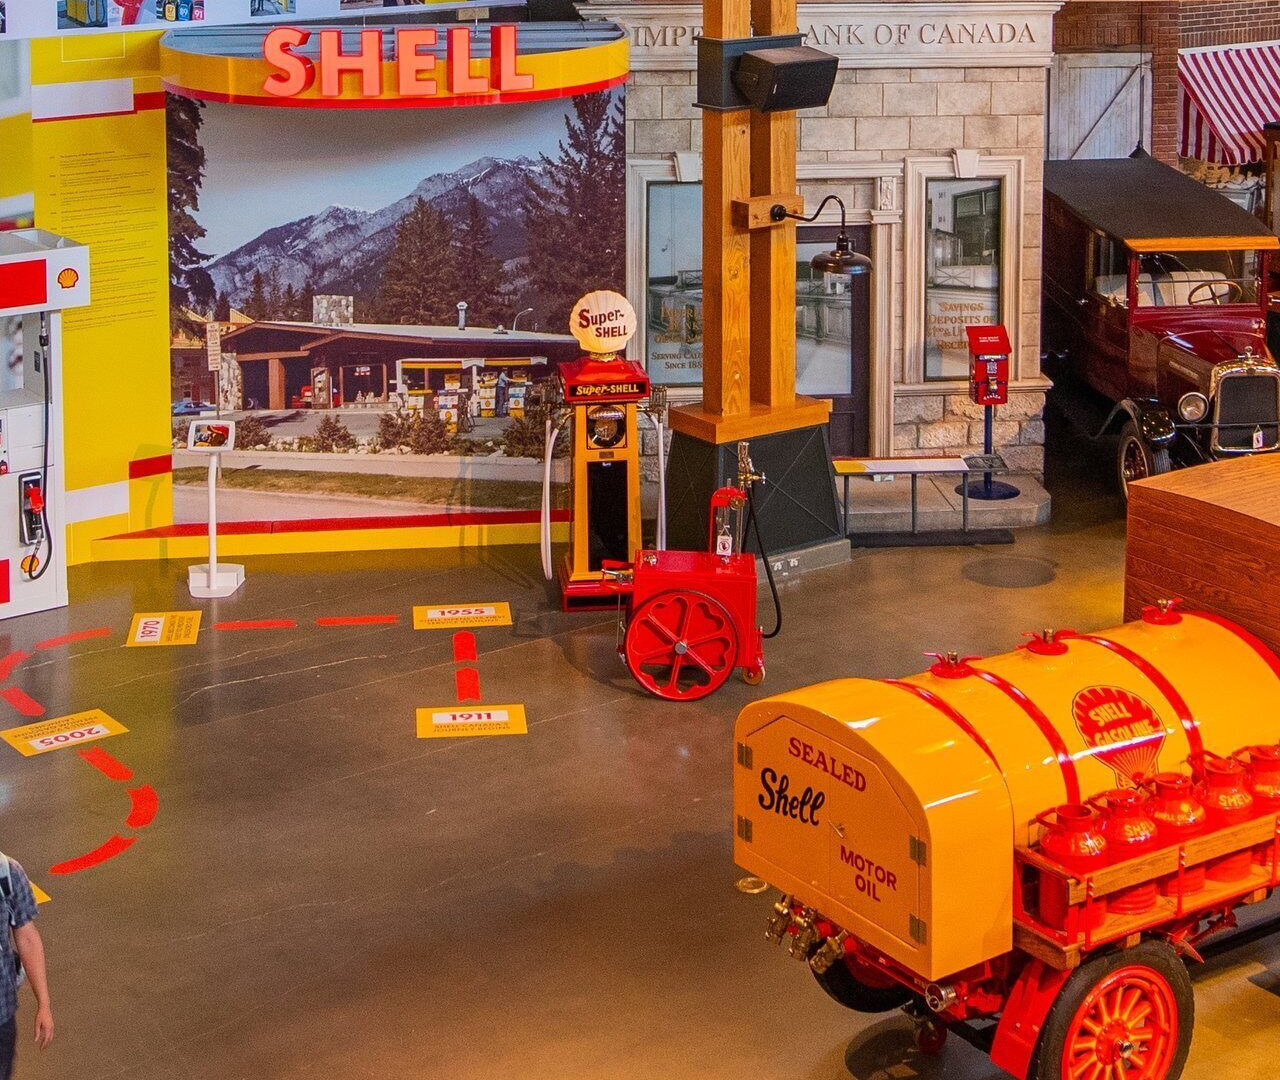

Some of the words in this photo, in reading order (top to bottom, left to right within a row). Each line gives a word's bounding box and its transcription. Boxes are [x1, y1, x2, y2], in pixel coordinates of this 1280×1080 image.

[633, 25, 703, 48] IMPE
[803, 24, 867, 46] ANK
[874, 22, 911, 46] OF
[919, 22, 1037, 45] CANADA
[261, 24, 534, 98] SHELL
[939, 303, 984, 311] SAVINGS
[578, 308, 624, 329] Super-
[928, 315, 980, 324] DEPOSITS
[595, 325, 628, 338] SHELL
[651, 352, 681, 360] SERVING
[576, 384, 639, 396] Super-SHELL
[438, 608, 486, 617] 1955
[140, 620, 160, 638] 1970
[449, 712, 492, 721] 1911
[1088, 701, 1132, 728] SHELL
[39, 727, 101, 746] 2005
[1095, 718, 1154, 747] GASOLINE
[788, 736, 867, 792] SEALED
[758, 767, 826, 826] Shell
[840, 845, 897, 891] MOTOR
[855, 874, 881, 902] OIL
